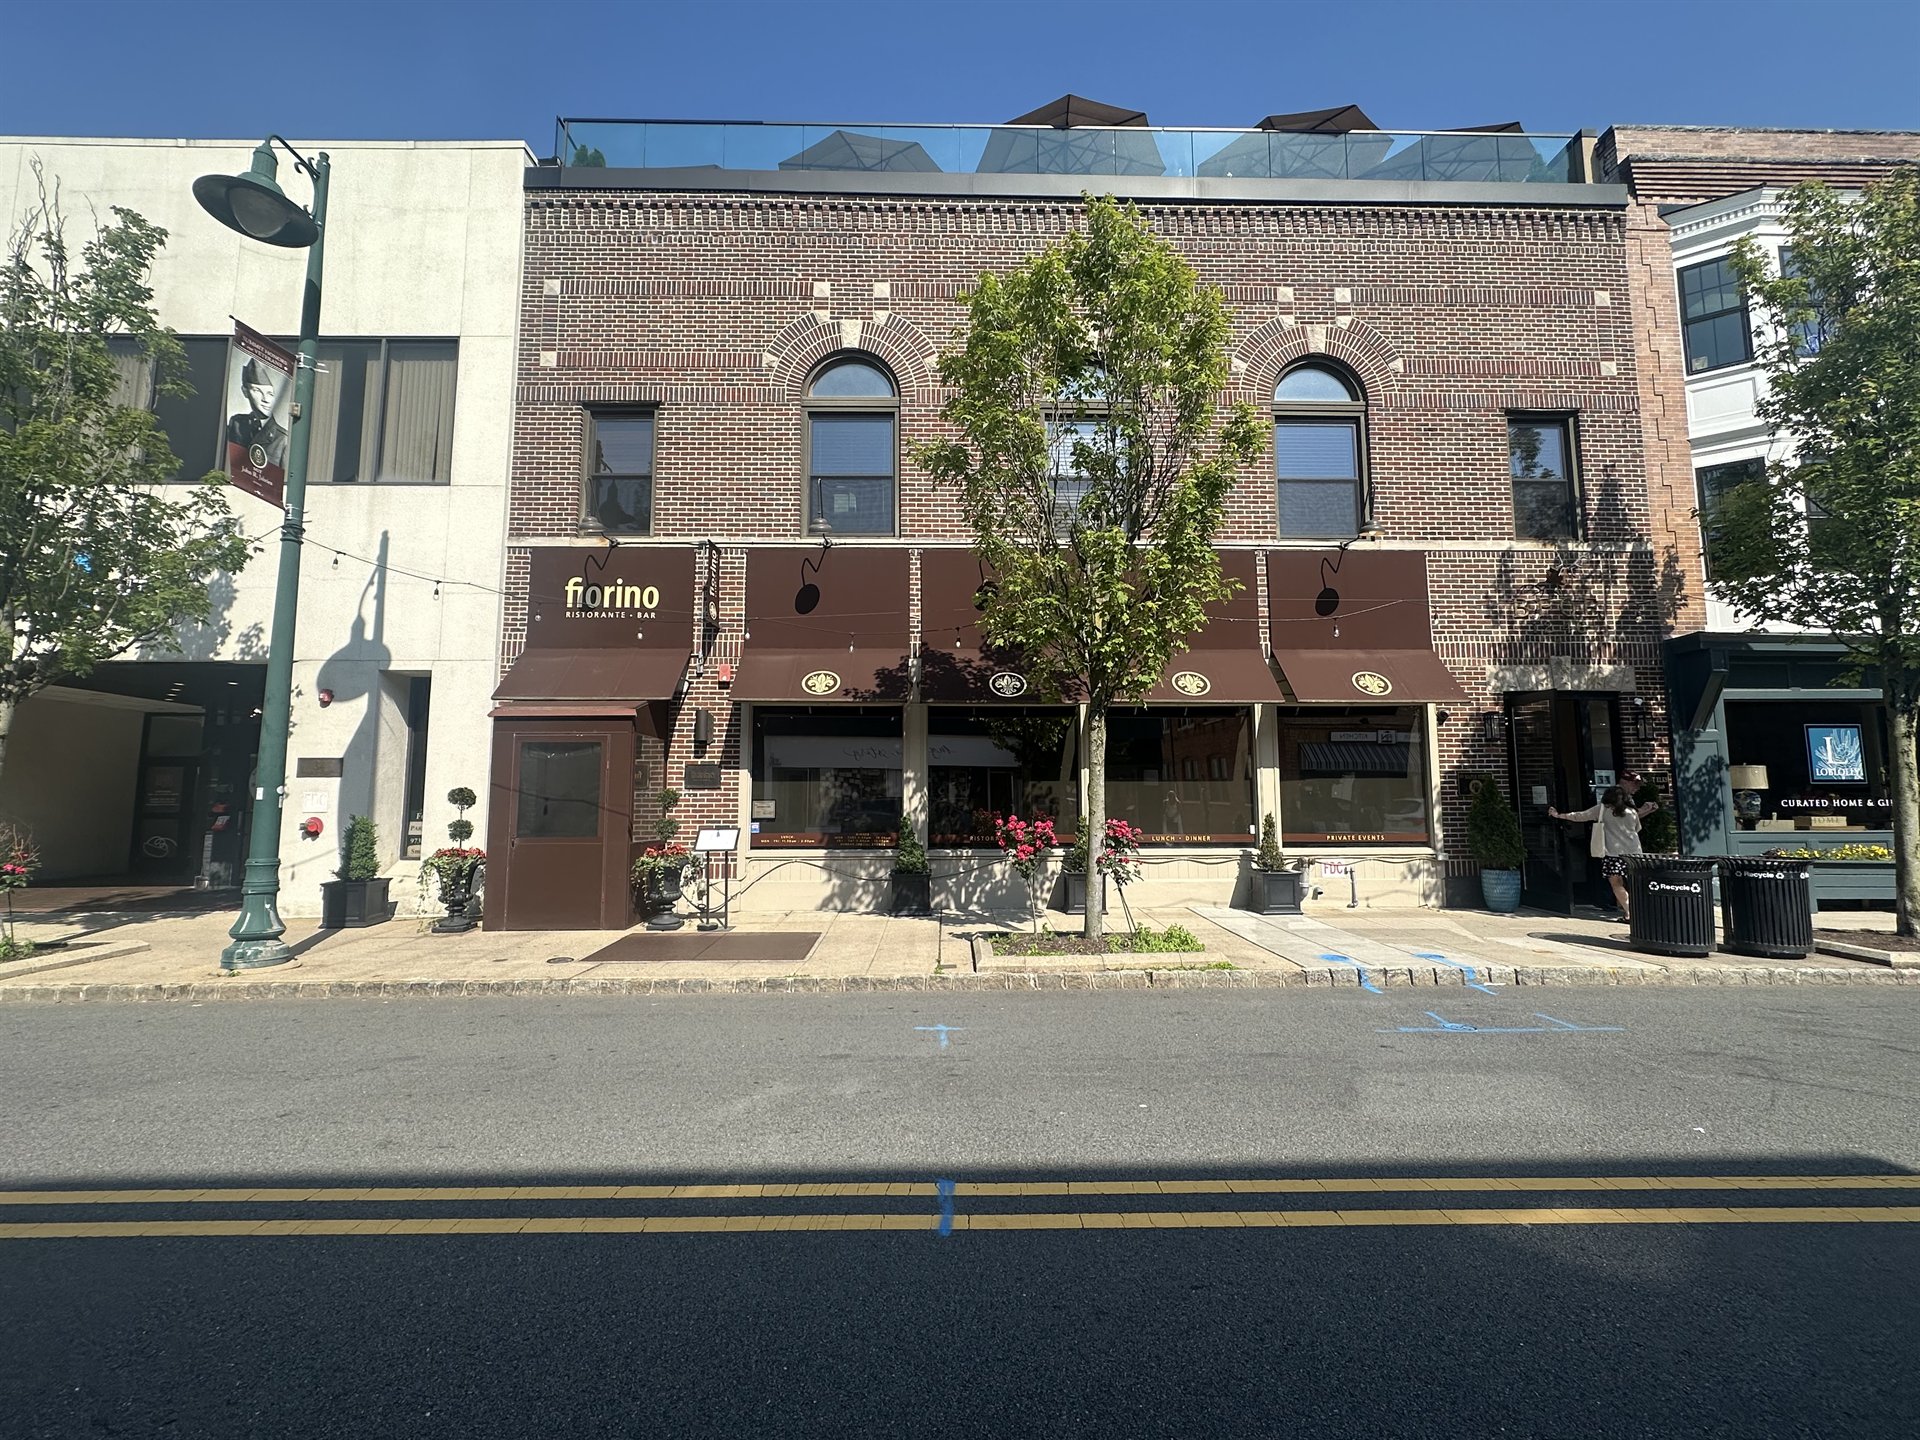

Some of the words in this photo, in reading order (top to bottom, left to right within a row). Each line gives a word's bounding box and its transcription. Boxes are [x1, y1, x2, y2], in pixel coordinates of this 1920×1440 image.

[564, 576, 660, 609] fiorino
[565, 611, 626, 619] RISTORANTE
[637, 611, 656, 619] BAR
[1822, 736, 1849, 764] L
[1780, 799, 1829, 807] CURATED
[1833, 799, 1864, 807] HOME
[1866, 799, 1875, 807] &
[1323, 861, 1344, 875] FDC
[1743, 870, 1775, 879] Recycle
[1660, 883, 1691, 892] Recycle
